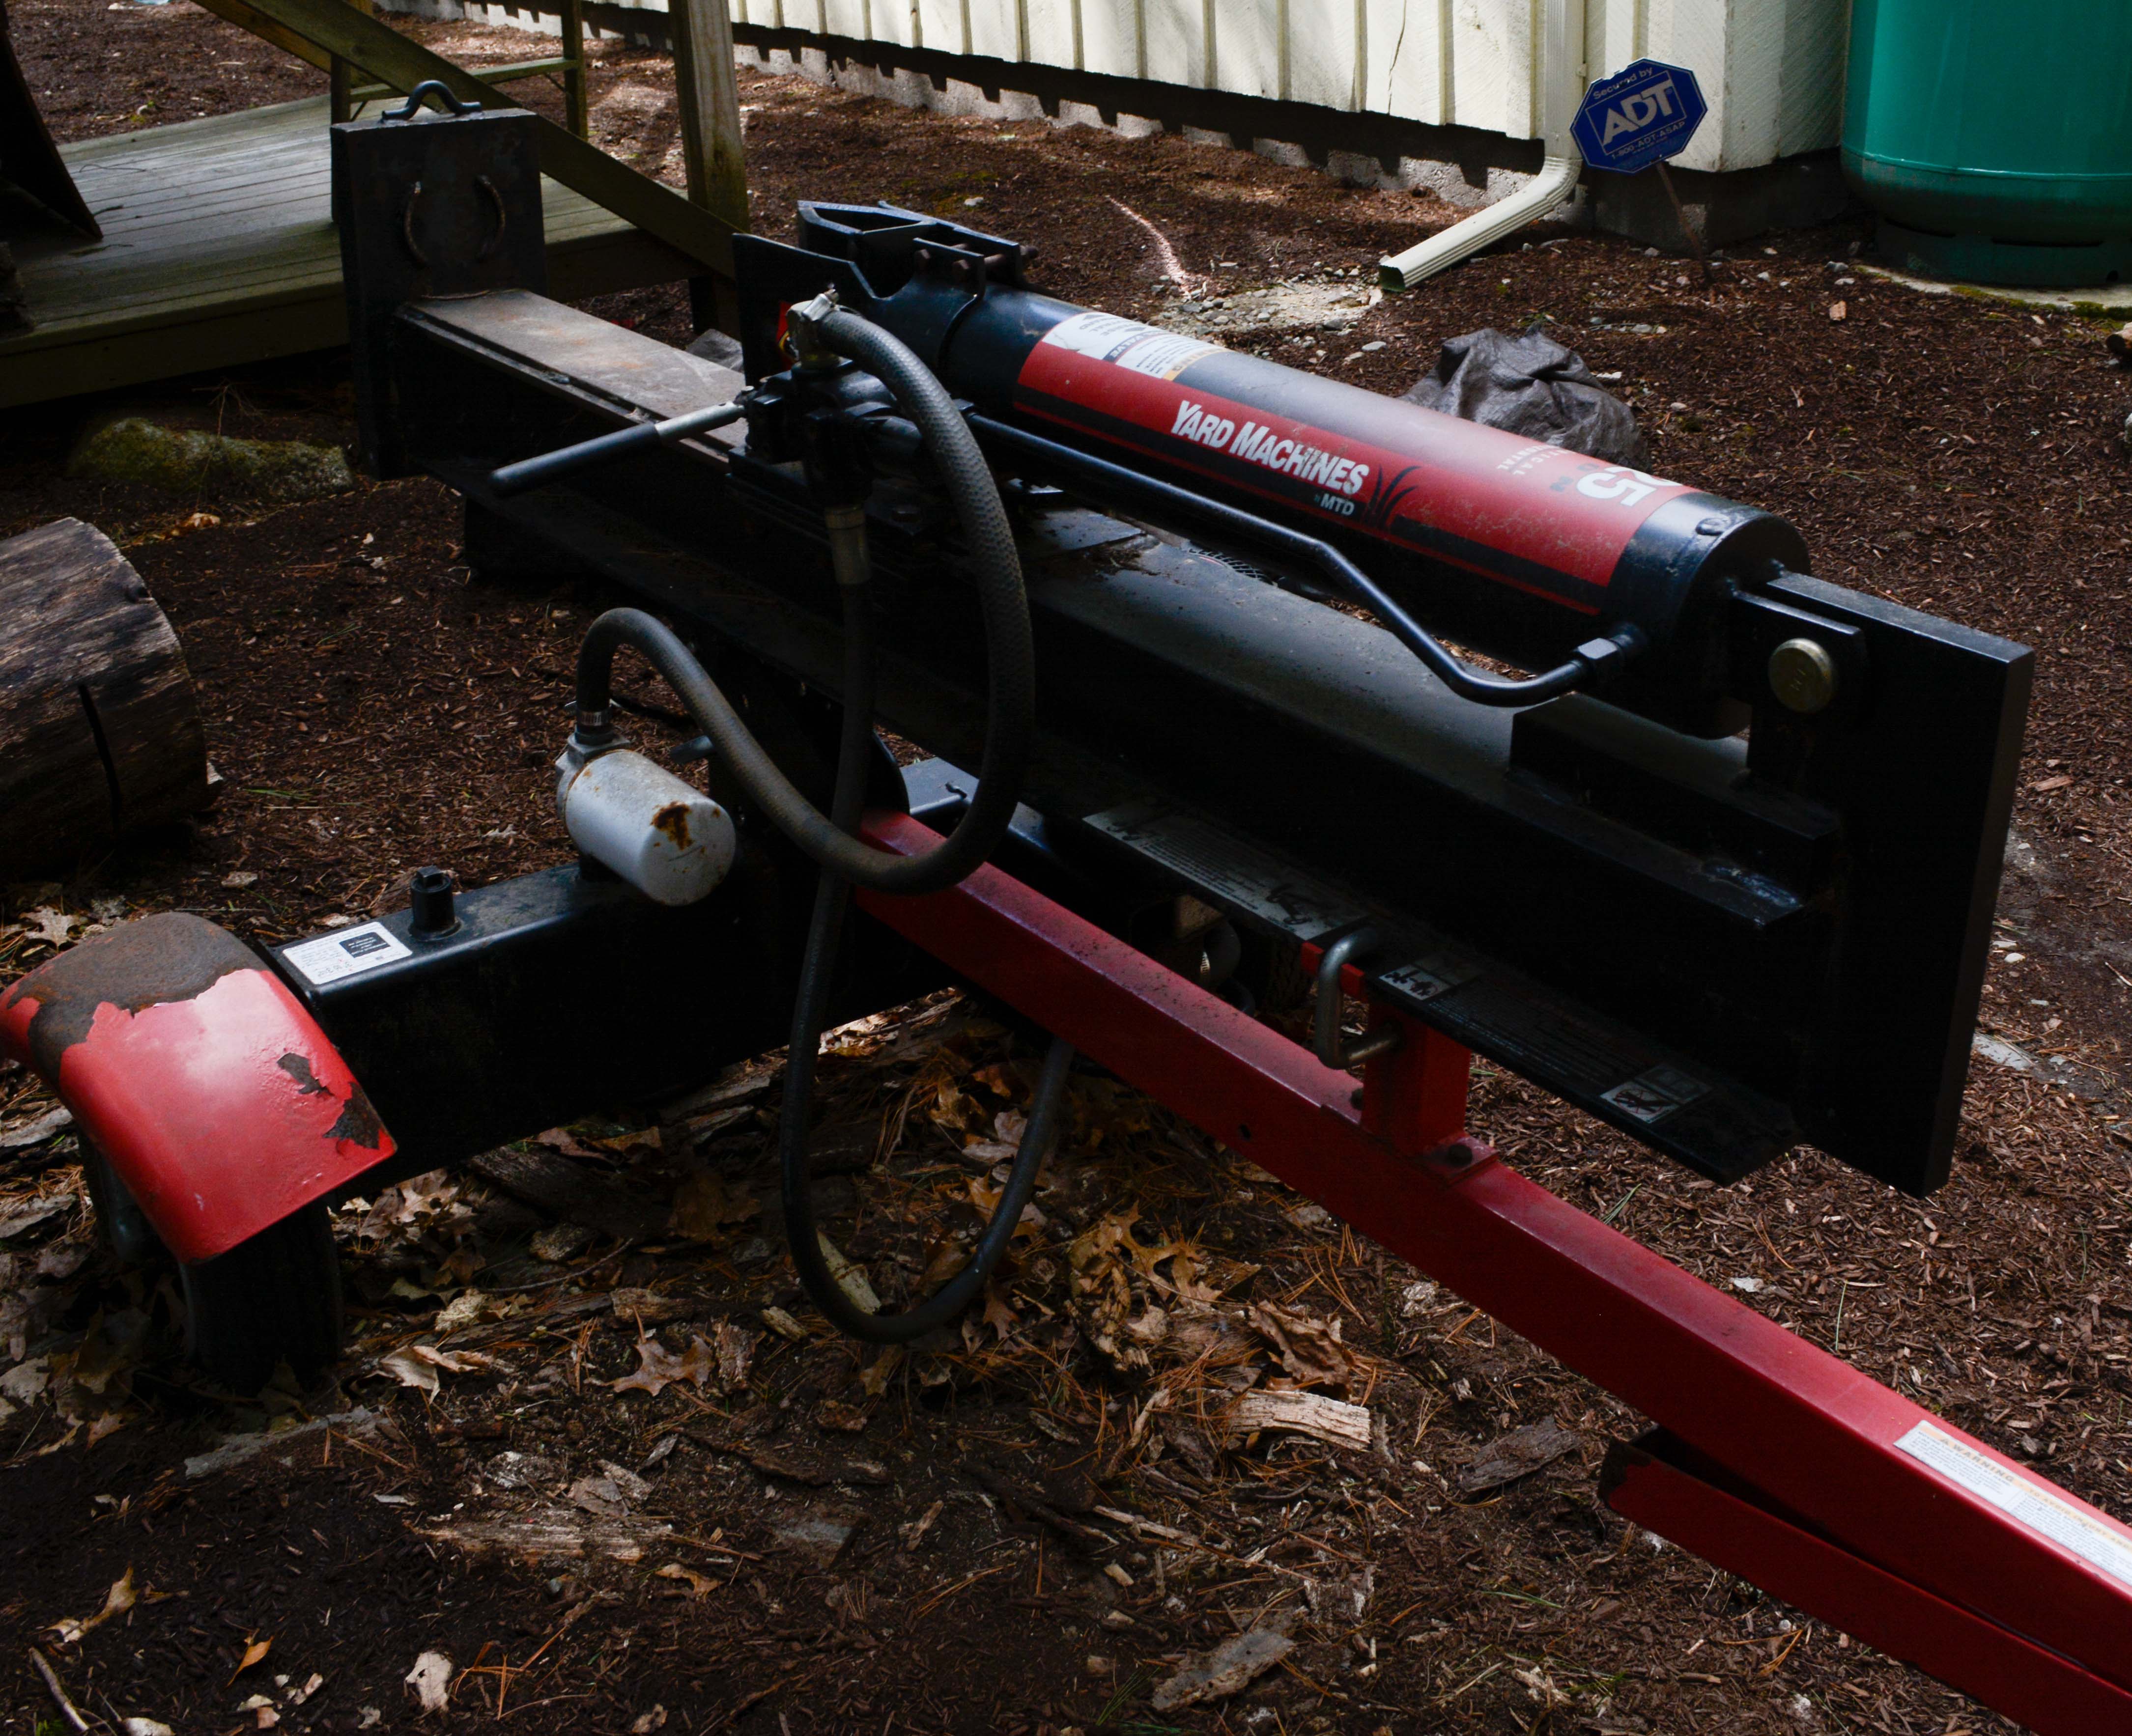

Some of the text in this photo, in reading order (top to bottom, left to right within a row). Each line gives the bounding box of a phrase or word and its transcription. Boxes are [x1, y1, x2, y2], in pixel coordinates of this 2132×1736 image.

[1603, 80, 1674, 146] ADT
[1171, 400, 1370, 495] YARD MACHINES
[1320, 494, 1355, 516] MTD
